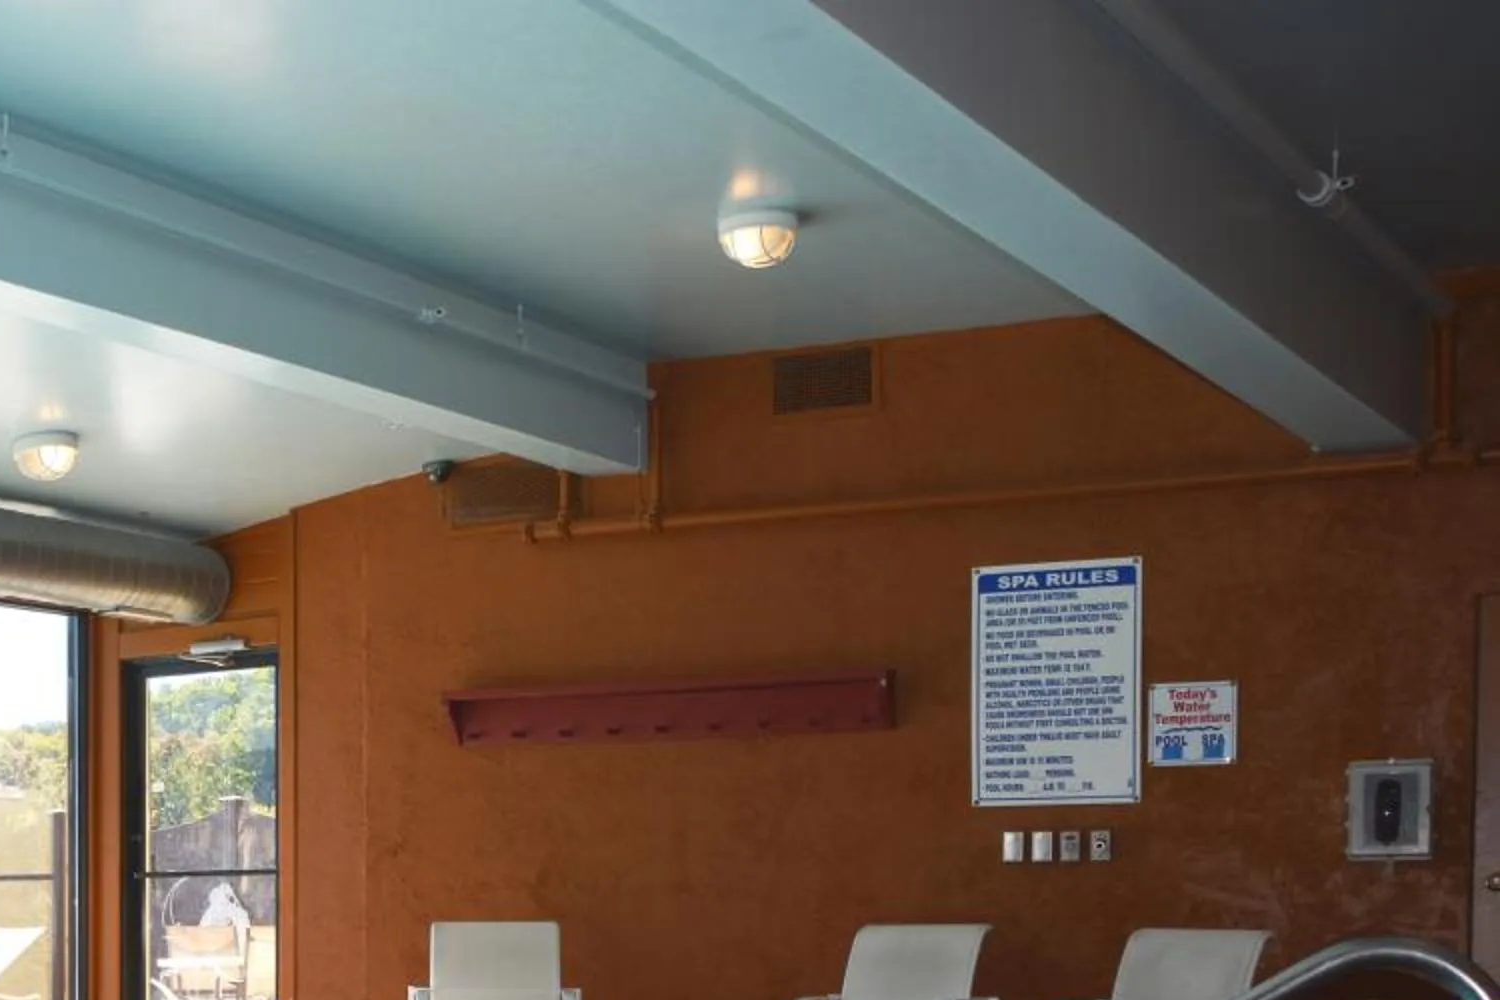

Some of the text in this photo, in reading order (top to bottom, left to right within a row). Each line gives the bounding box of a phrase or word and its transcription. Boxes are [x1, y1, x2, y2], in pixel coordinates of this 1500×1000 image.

[998, 569, 1119, 589] SPA RULES
[1168, 688, 1217, 701] Today's
[1173, 701, 1210, 712] Water
[1155, 713, 1231, 725] Temperature
[1156, 733, 1225, 748] POOL SPA
